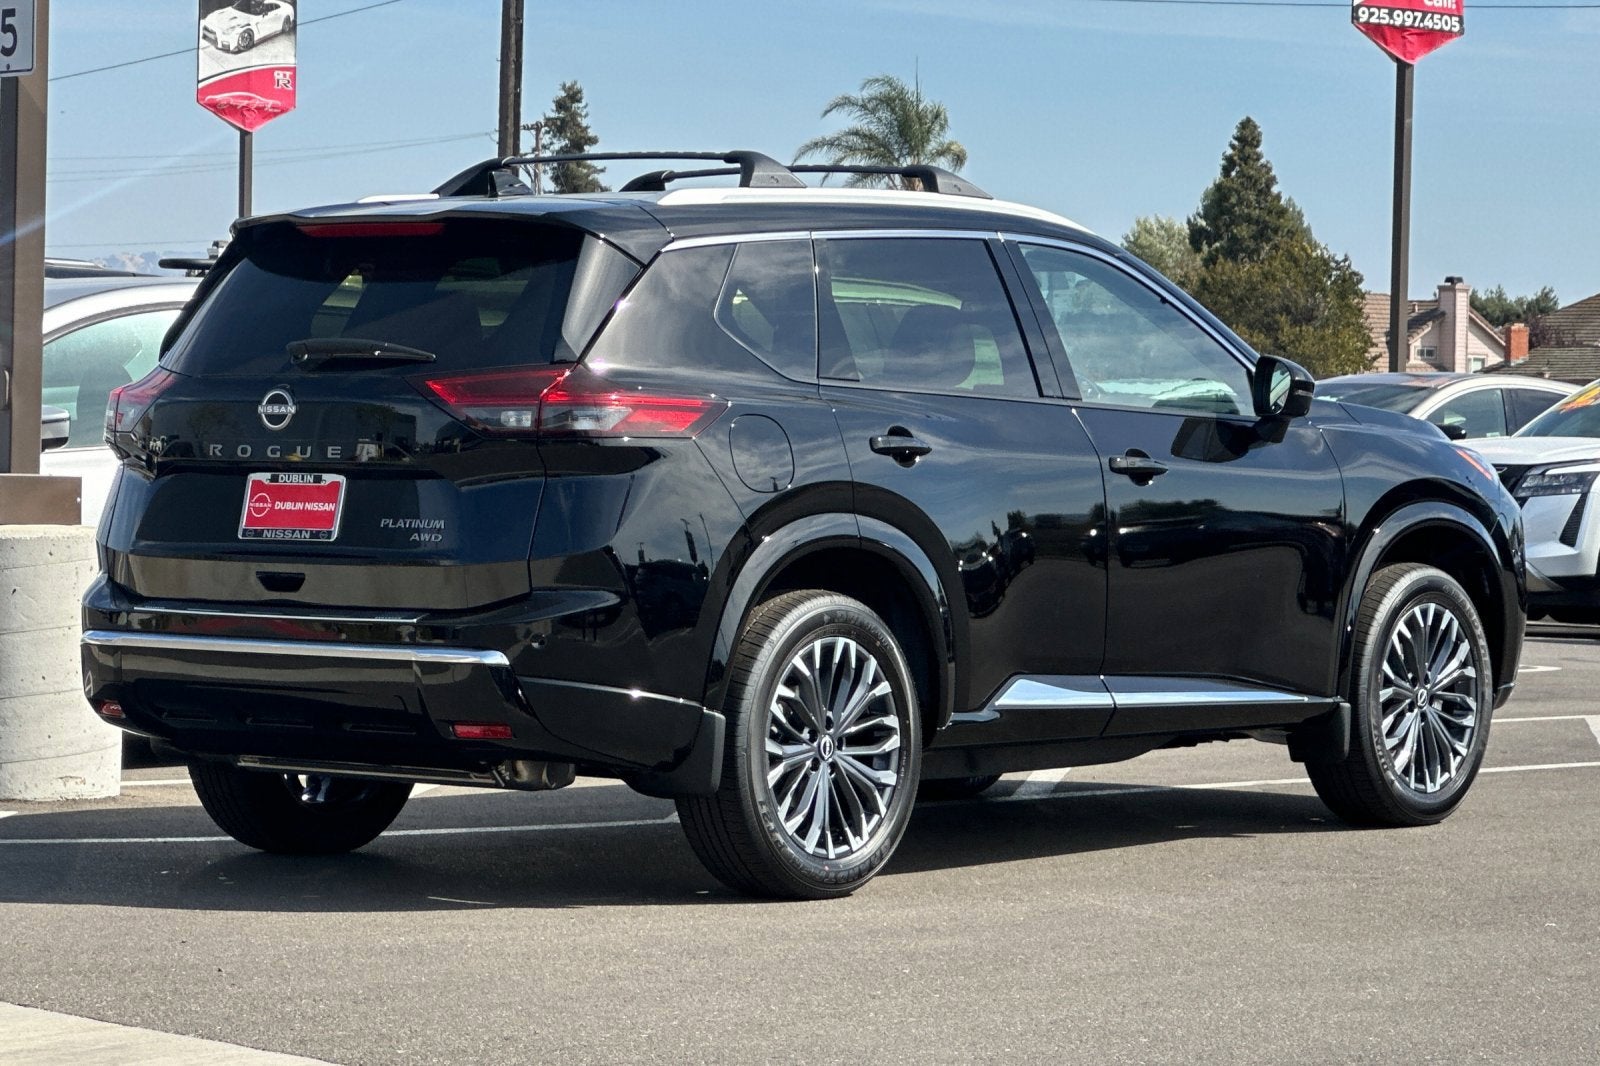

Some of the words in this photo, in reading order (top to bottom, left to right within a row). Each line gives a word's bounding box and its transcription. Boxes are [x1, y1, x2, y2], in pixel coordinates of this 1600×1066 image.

[1358, 7, 1461, 32] 925.997.4505
[258, 405, 296, 414] NISSAN
[209, 443, 342, 458] ROGUE
[278, 474, 314, 483] DUBLIN
[274, 500, 304, 511] DUBLIN
[304, 502, 336, 512] NISSAN
[380, 518, 445, 529] PLATINUM
[262, 529, 311, 539] NISSAN
[409, 533, 442, 542] AWD
